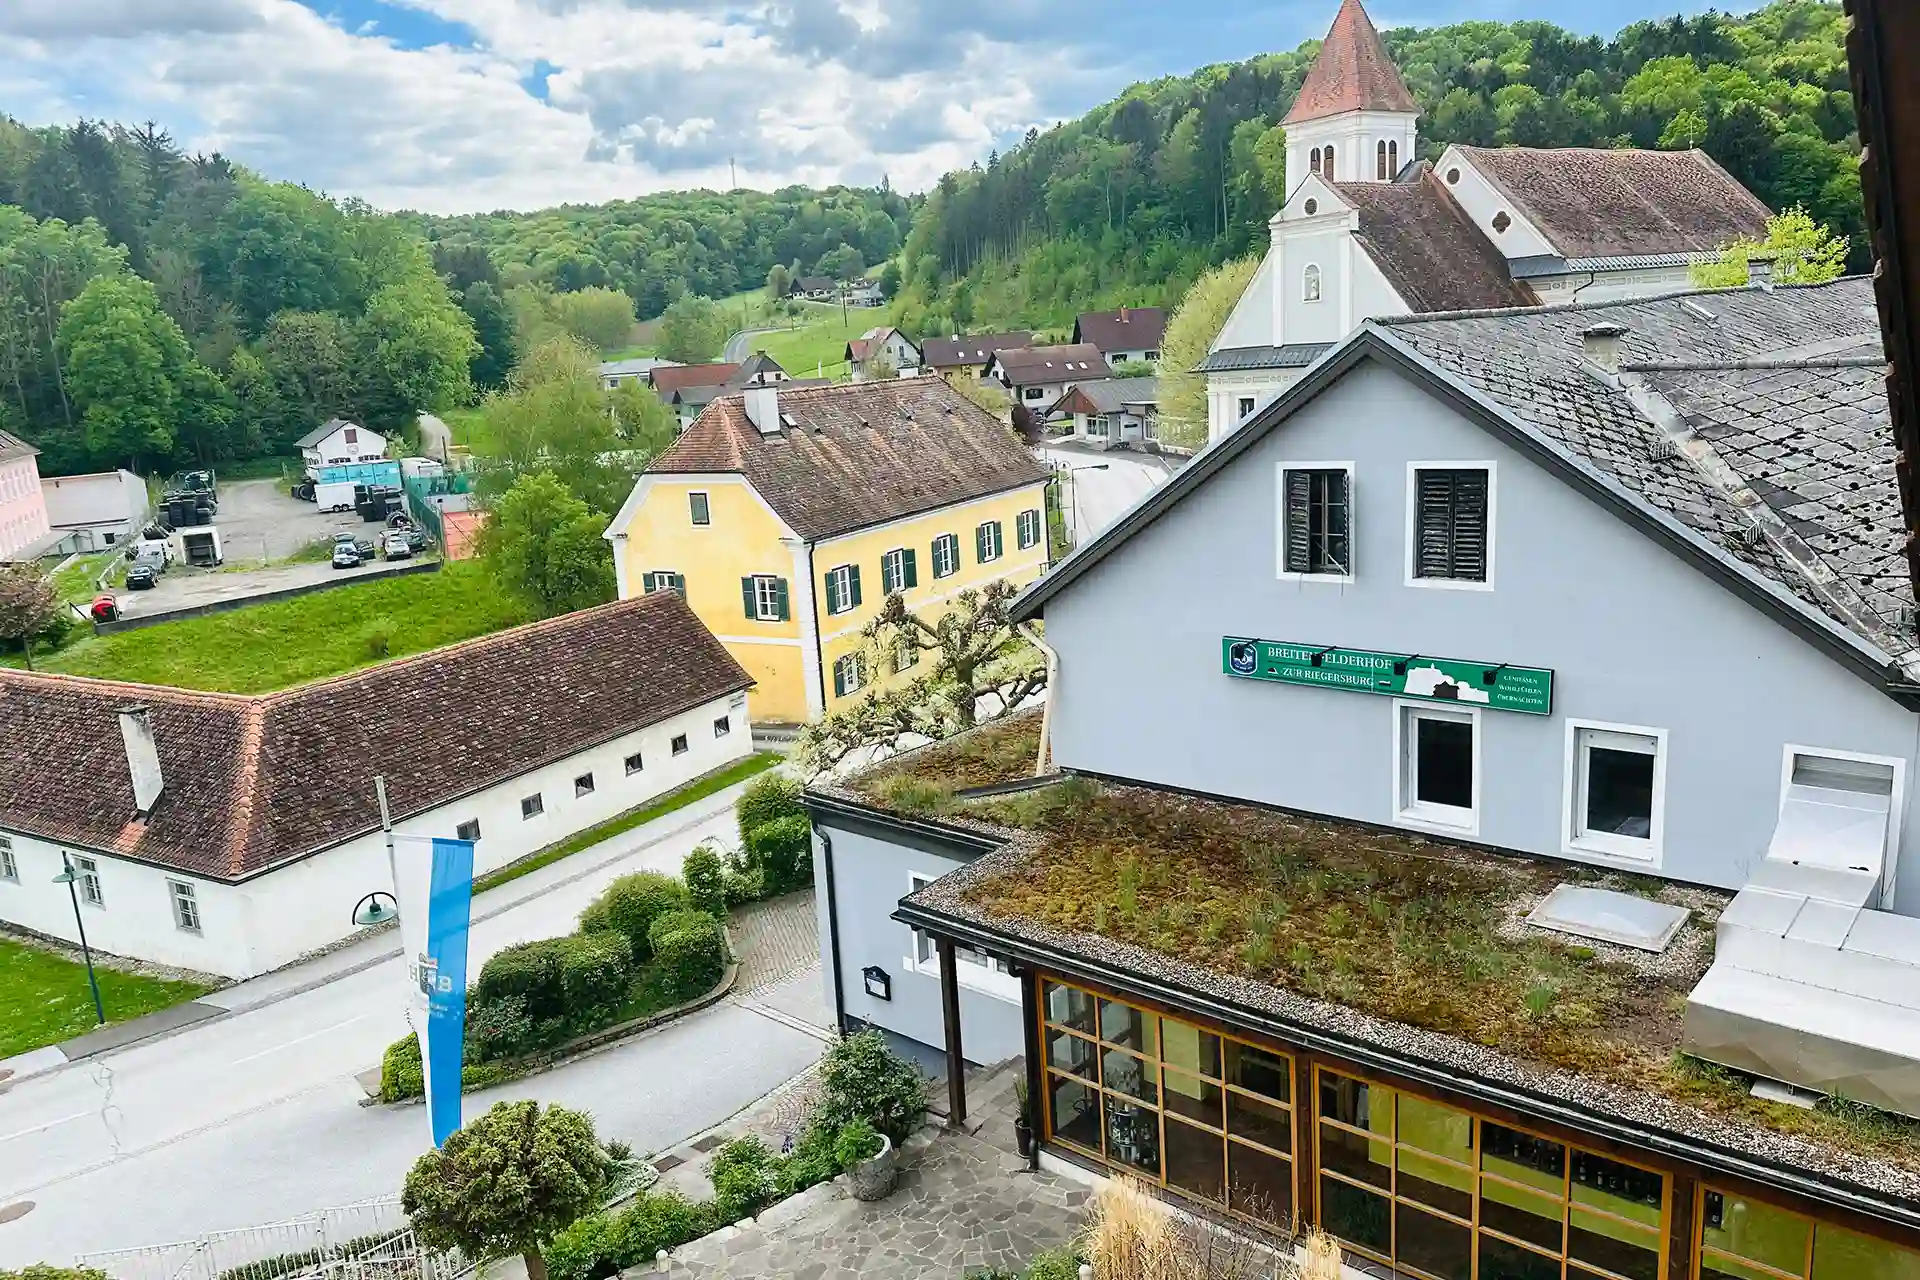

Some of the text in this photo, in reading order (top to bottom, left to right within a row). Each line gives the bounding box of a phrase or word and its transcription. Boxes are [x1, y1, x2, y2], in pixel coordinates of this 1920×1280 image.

[1267, 646, 1392, 669] BREITENELDERHOF
[1282, 667, 1374, 686] ZUR RIEGERSBURG
